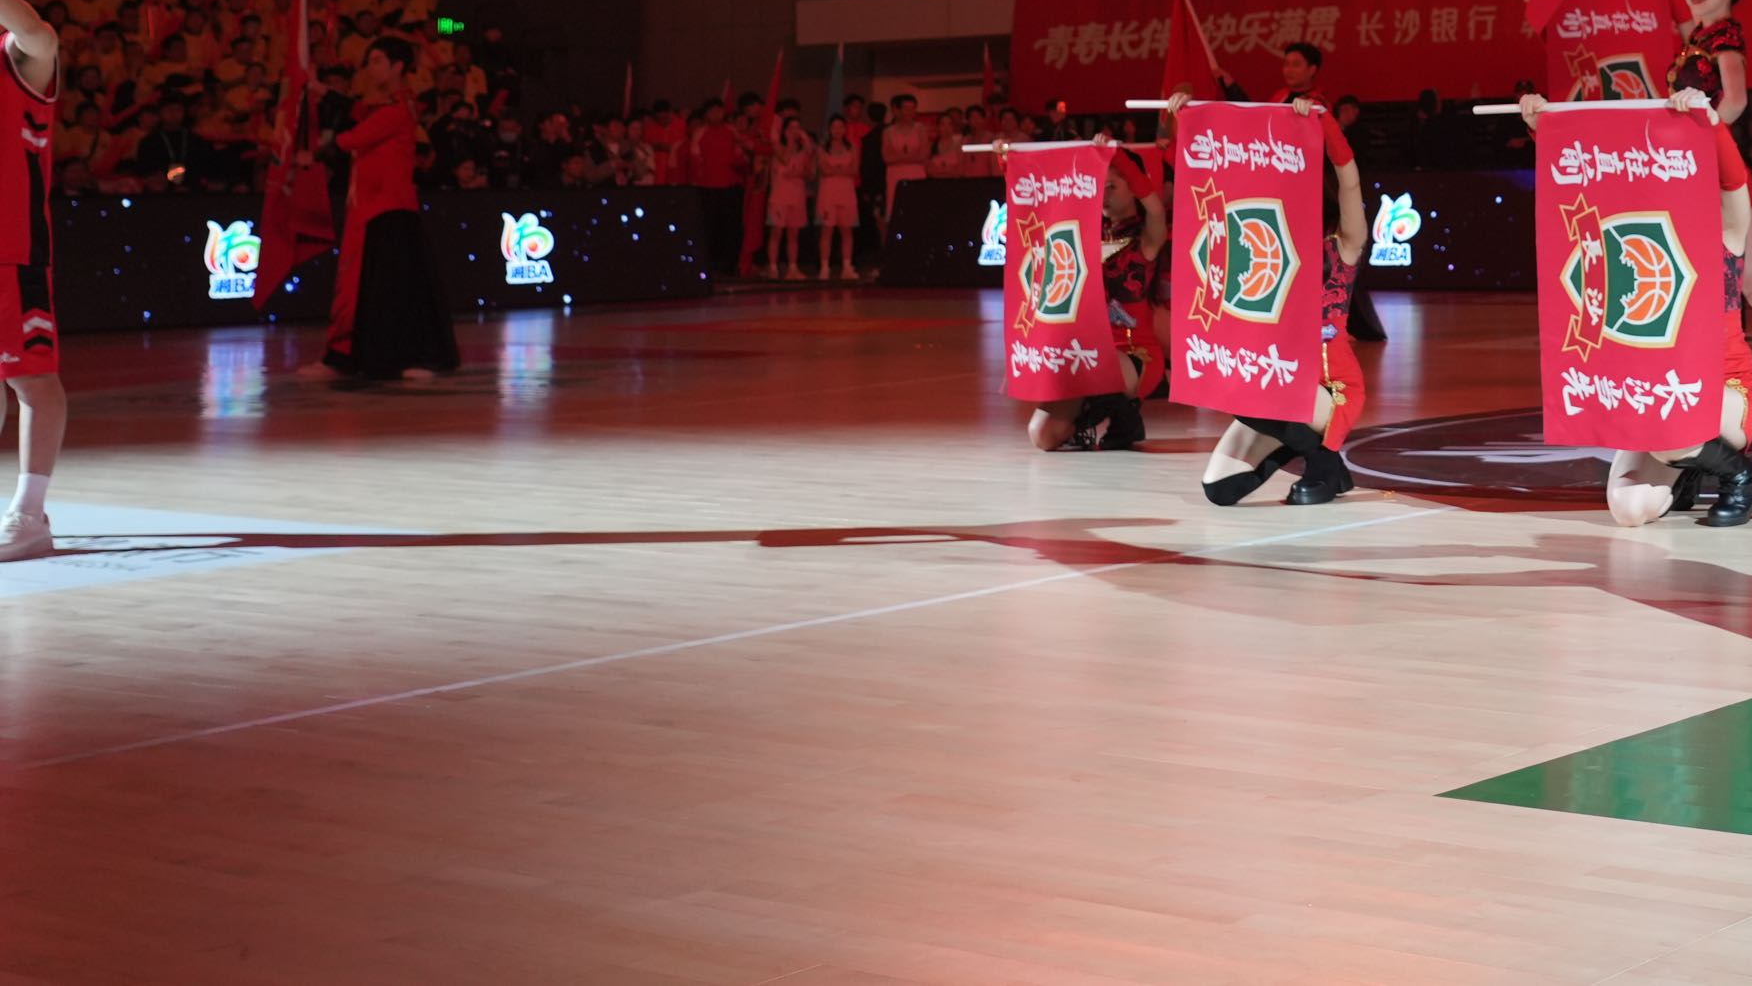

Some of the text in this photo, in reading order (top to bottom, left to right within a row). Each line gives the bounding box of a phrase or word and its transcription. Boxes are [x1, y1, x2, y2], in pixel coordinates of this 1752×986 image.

[1357, 5, 1497, 48] 长沙银行
[1184, 117, 1307, 174] 勇往直前
[1550, 119, 1698, 188] 勇往直前
[1011, 156, 1098, 208] 勇往直前
[1185, 333, 1298, 390] 长沙当先
[1560, 367, 1703, 422] 长沙当先
